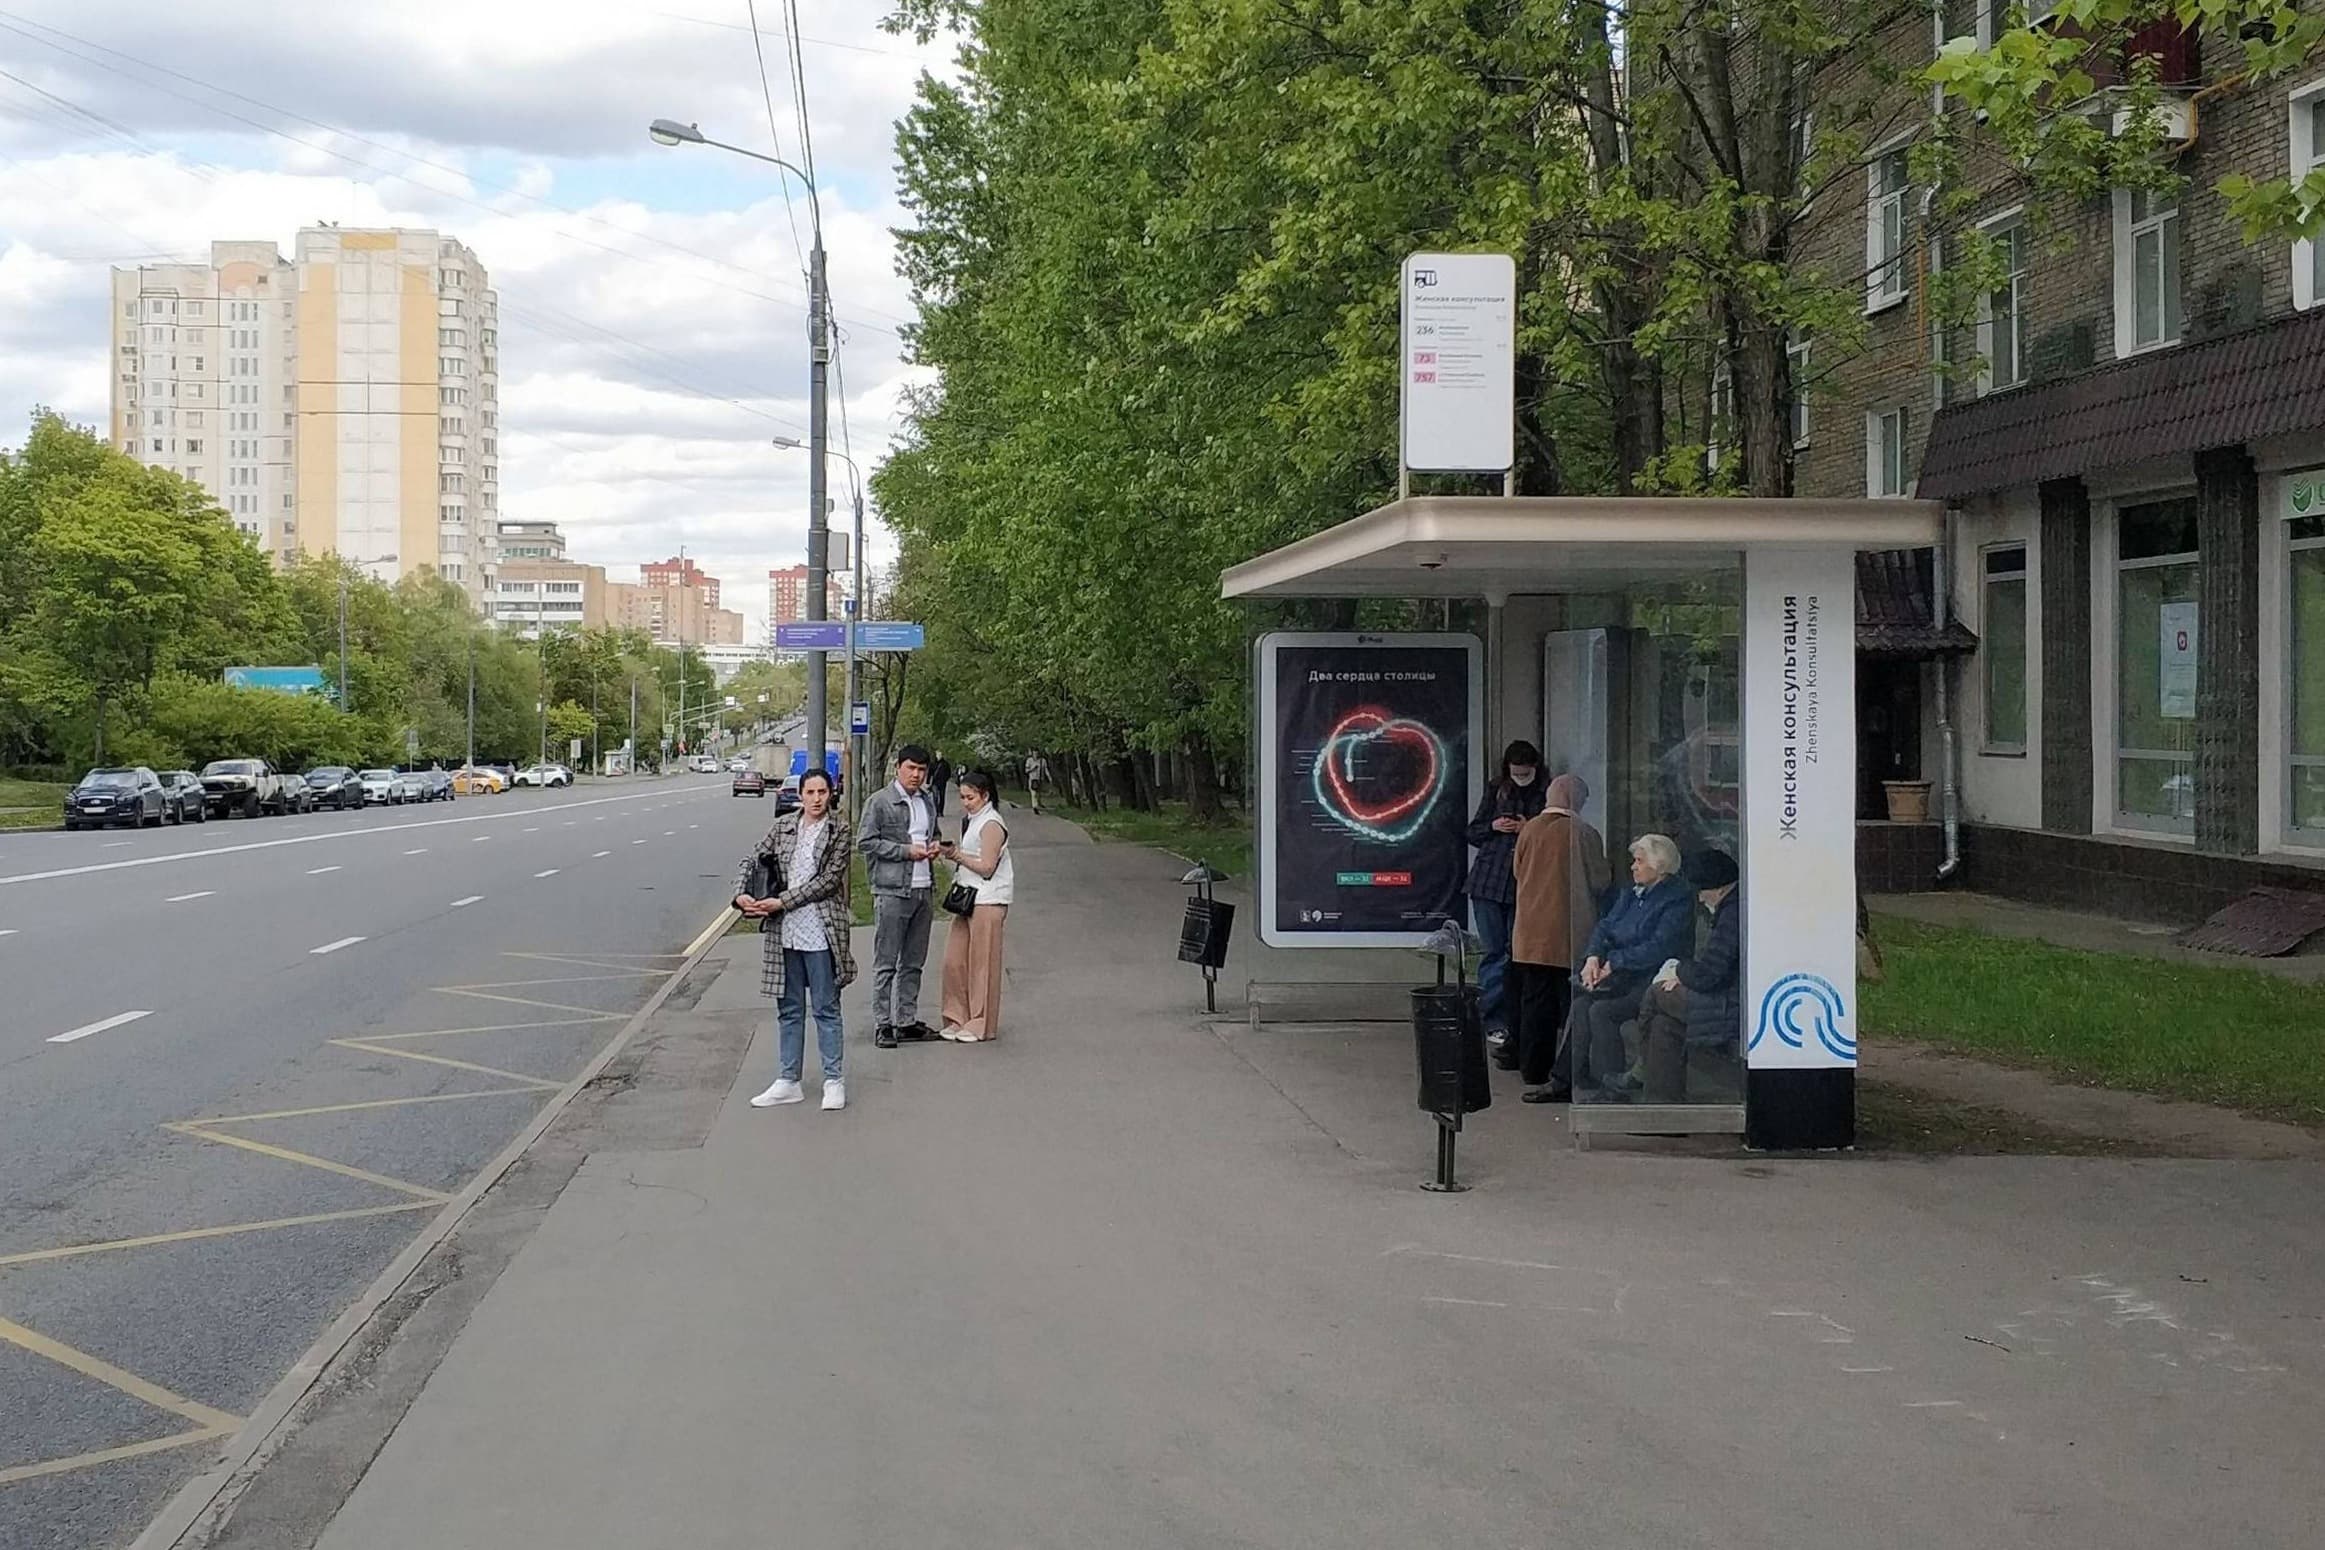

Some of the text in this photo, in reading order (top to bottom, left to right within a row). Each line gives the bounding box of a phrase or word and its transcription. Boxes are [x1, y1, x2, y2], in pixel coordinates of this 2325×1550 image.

[1308, 670, 1436, 683] Два сердца столицы
[1779, 596, 1800, 840] Женская консультация
[1805, 596, 1820, 764] Zhenskaya Konsultatsiya
